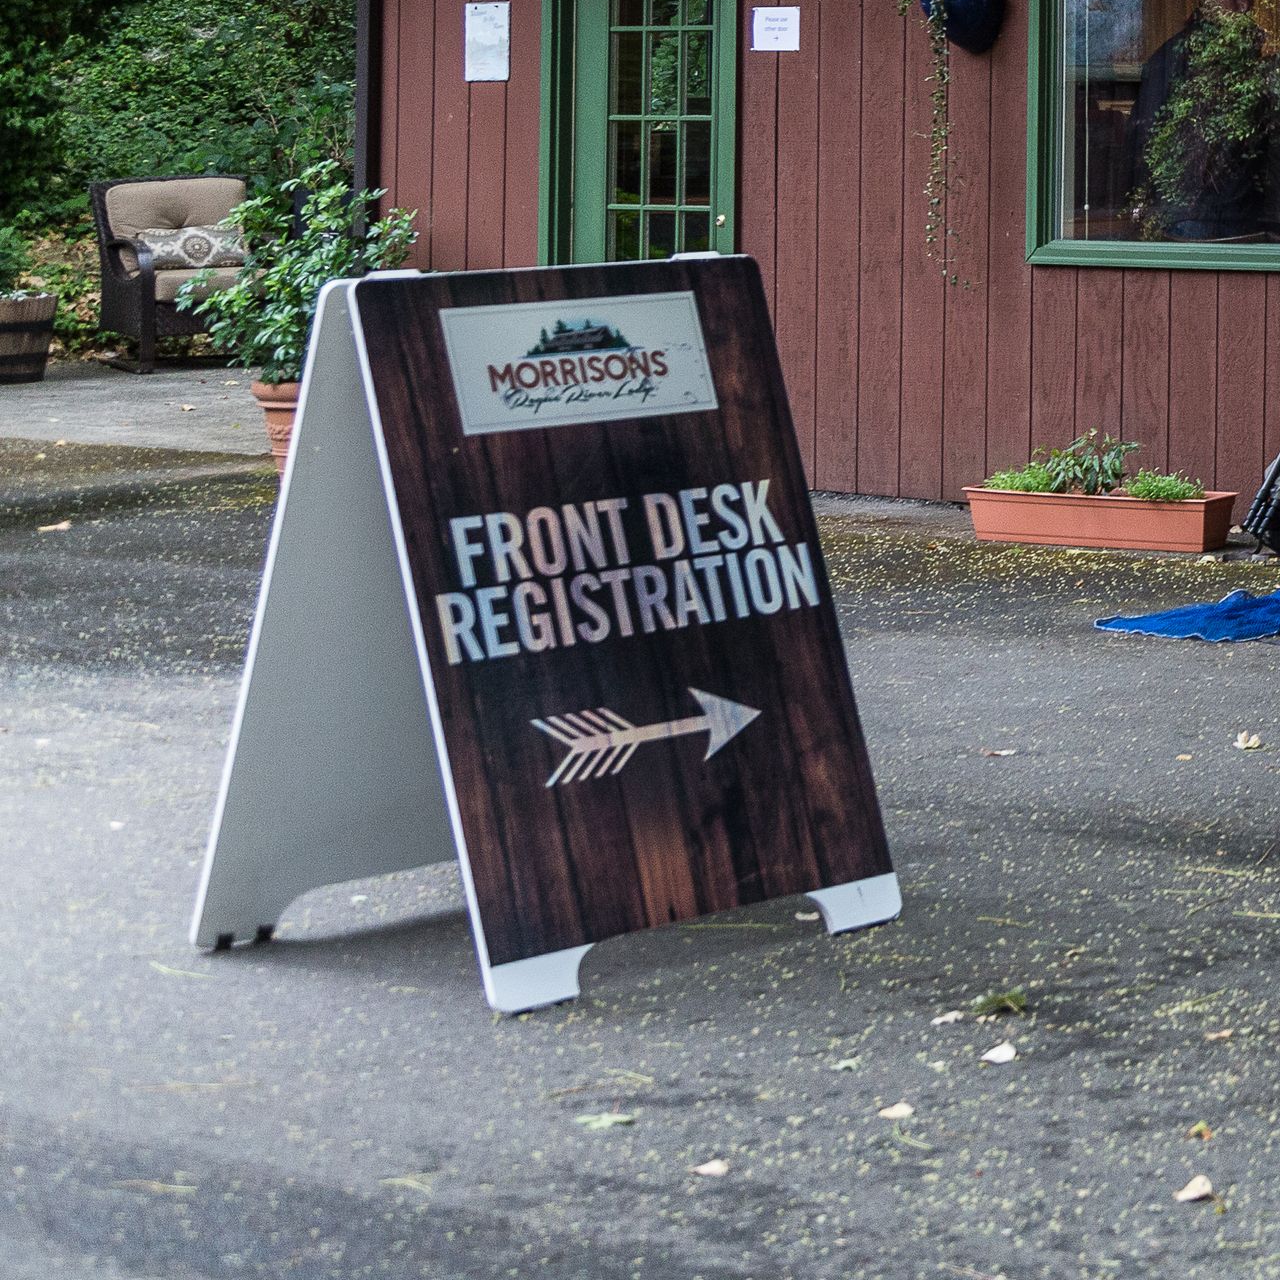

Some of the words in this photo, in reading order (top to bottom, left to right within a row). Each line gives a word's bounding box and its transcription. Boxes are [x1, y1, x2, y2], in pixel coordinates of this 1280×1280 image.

[487, 350, 669, 392] MORRISONS
[450, 495, 629, 587] FRONT
[645, 479, 785, 561] DESK
[436, 543, 820, 665] REGISTRATION
